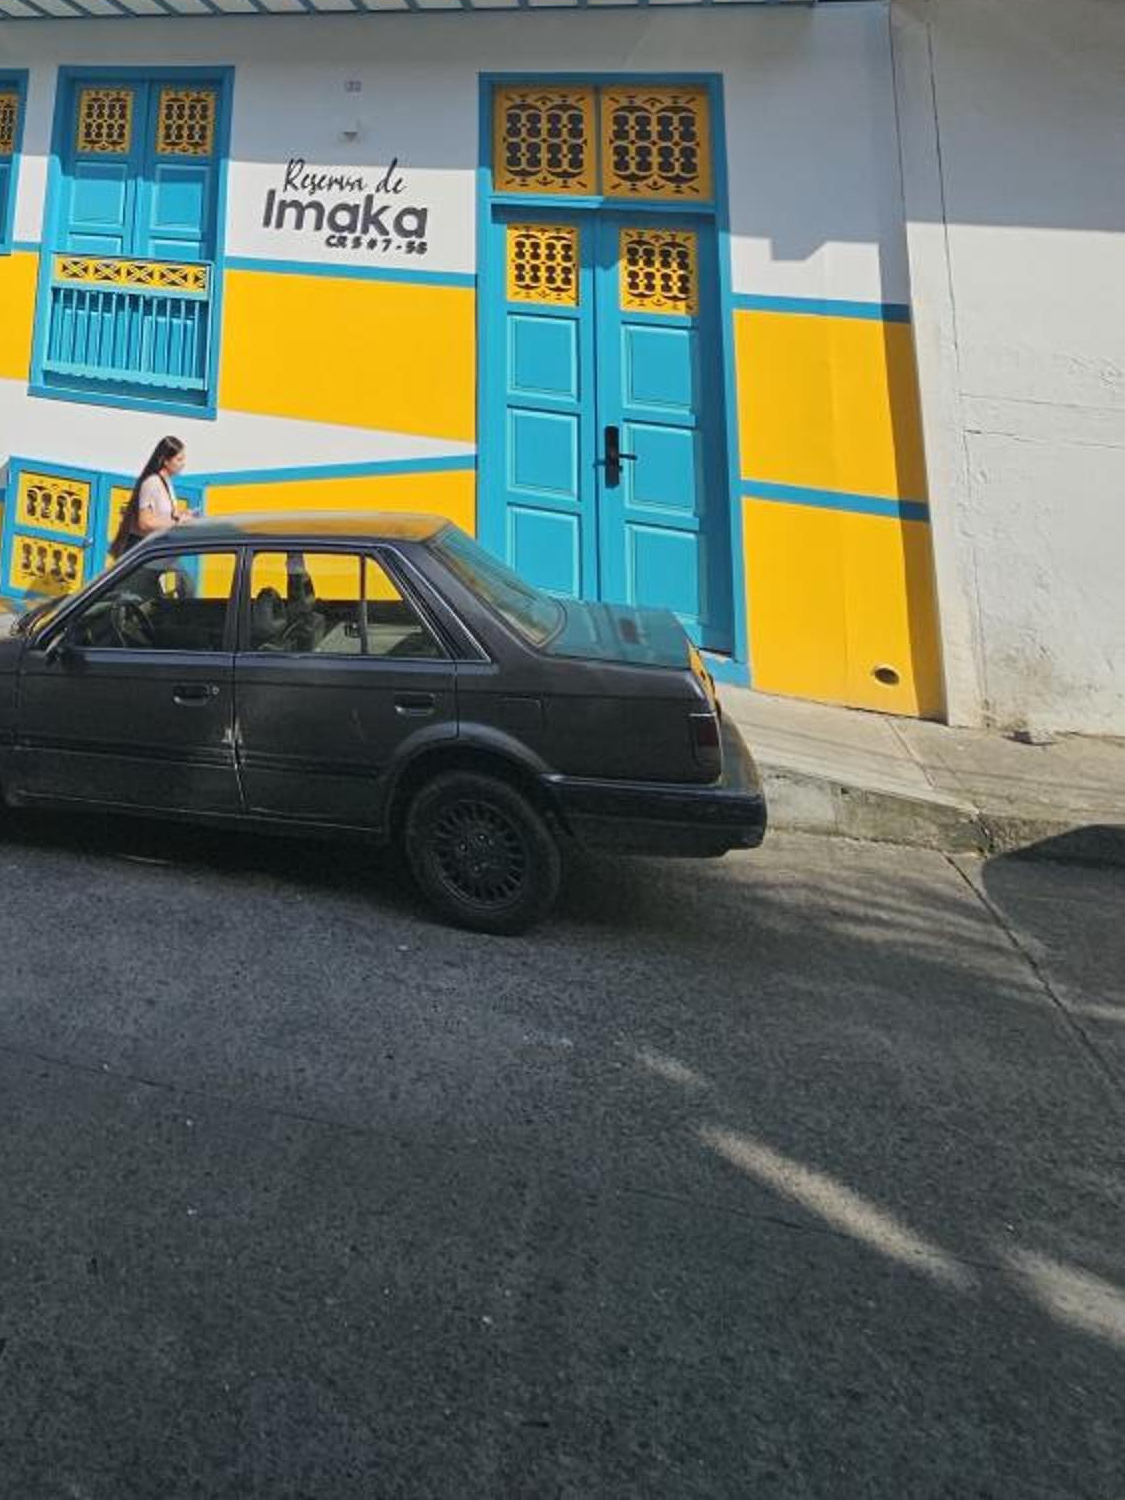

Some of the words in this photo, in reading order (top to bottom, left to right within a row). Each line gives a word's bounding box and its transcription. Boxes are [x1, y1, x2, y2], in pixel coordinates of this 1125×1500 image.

[282, 157, 365, 195] Reserva
[375, 156, 407, 195] de
[262, 188, 428, 239] Imaka
